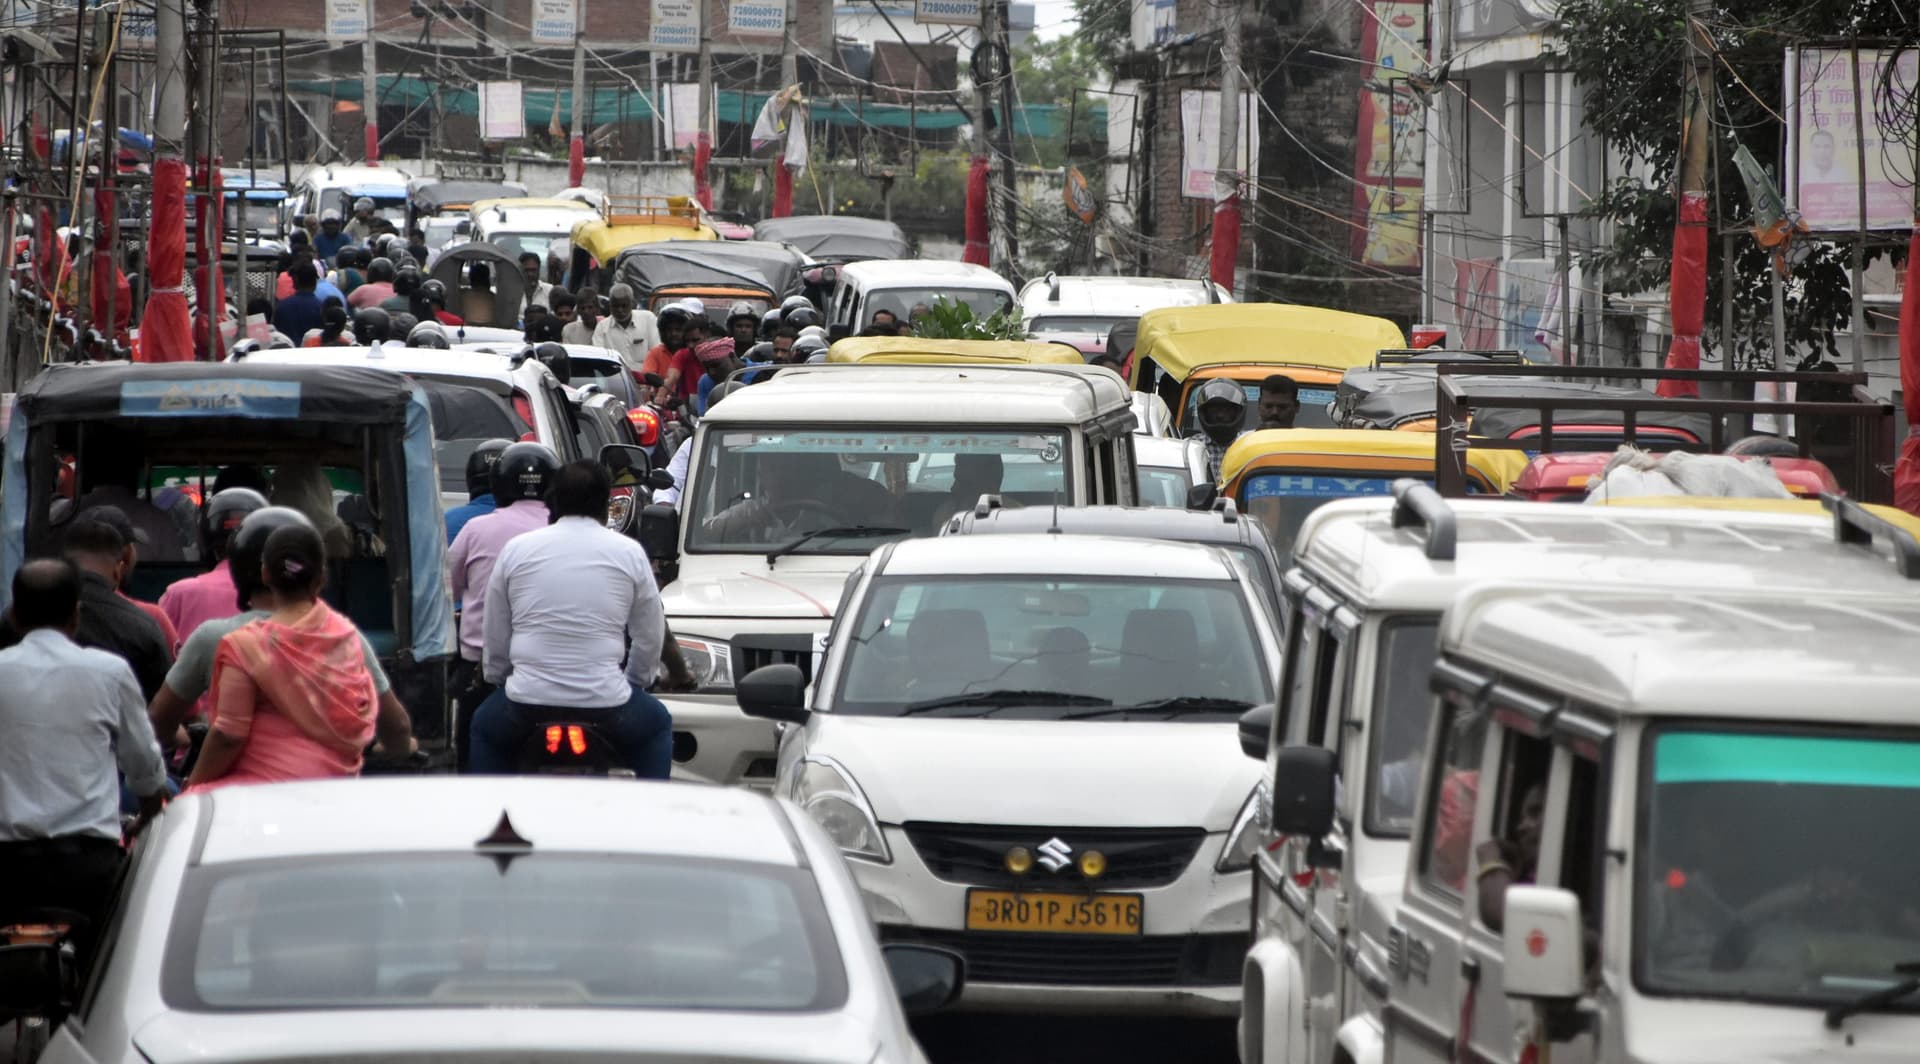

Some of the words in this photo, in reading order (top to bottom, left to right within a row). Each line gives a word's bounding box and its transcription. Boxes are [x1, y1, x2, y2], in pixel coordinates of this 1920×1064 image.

[733, 6, 783, 17] 7280060972
[922, 2, 977, 15] 7280060975
[732, 17, 782, 28] 7280060975
